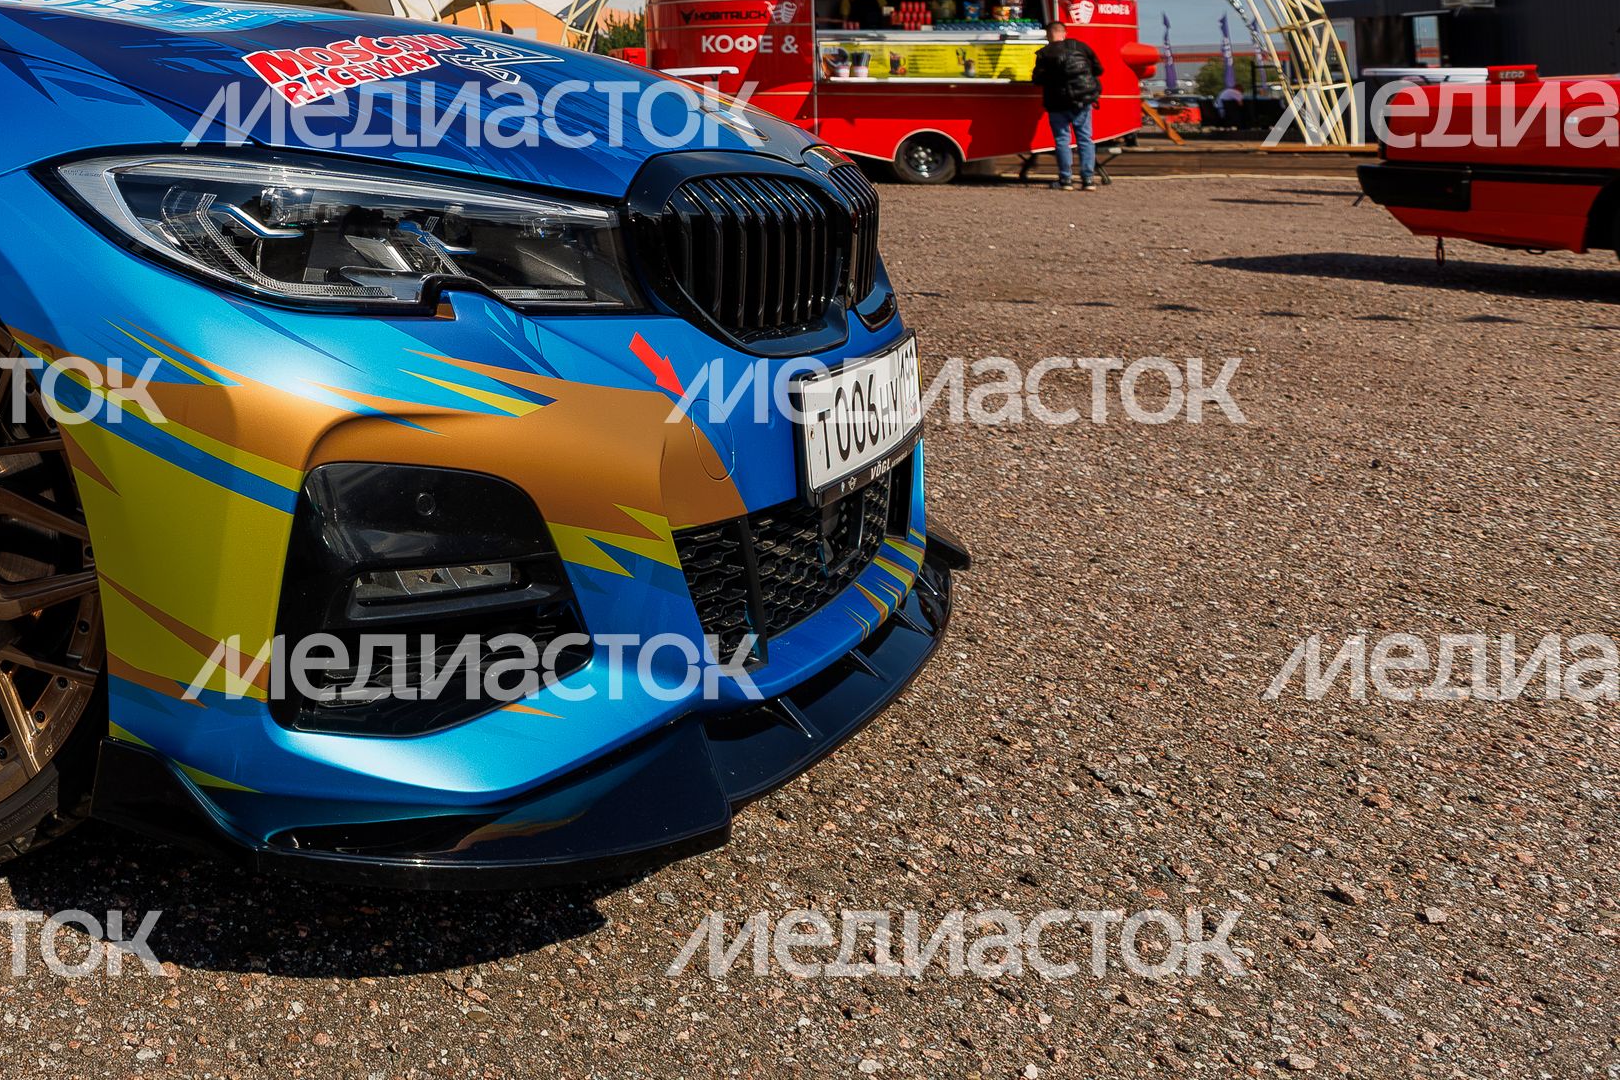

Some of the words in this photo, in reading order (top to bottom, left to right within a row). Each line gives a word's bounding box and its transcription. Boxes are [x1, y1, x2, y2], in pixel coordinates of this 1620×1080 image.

[242, 32, 465, 86] MOSCOW
[701, 34, 774, 54] КОФЕ
[780, 34, 799, 54] &
[280, 51, 442, 109] RACEWAY
